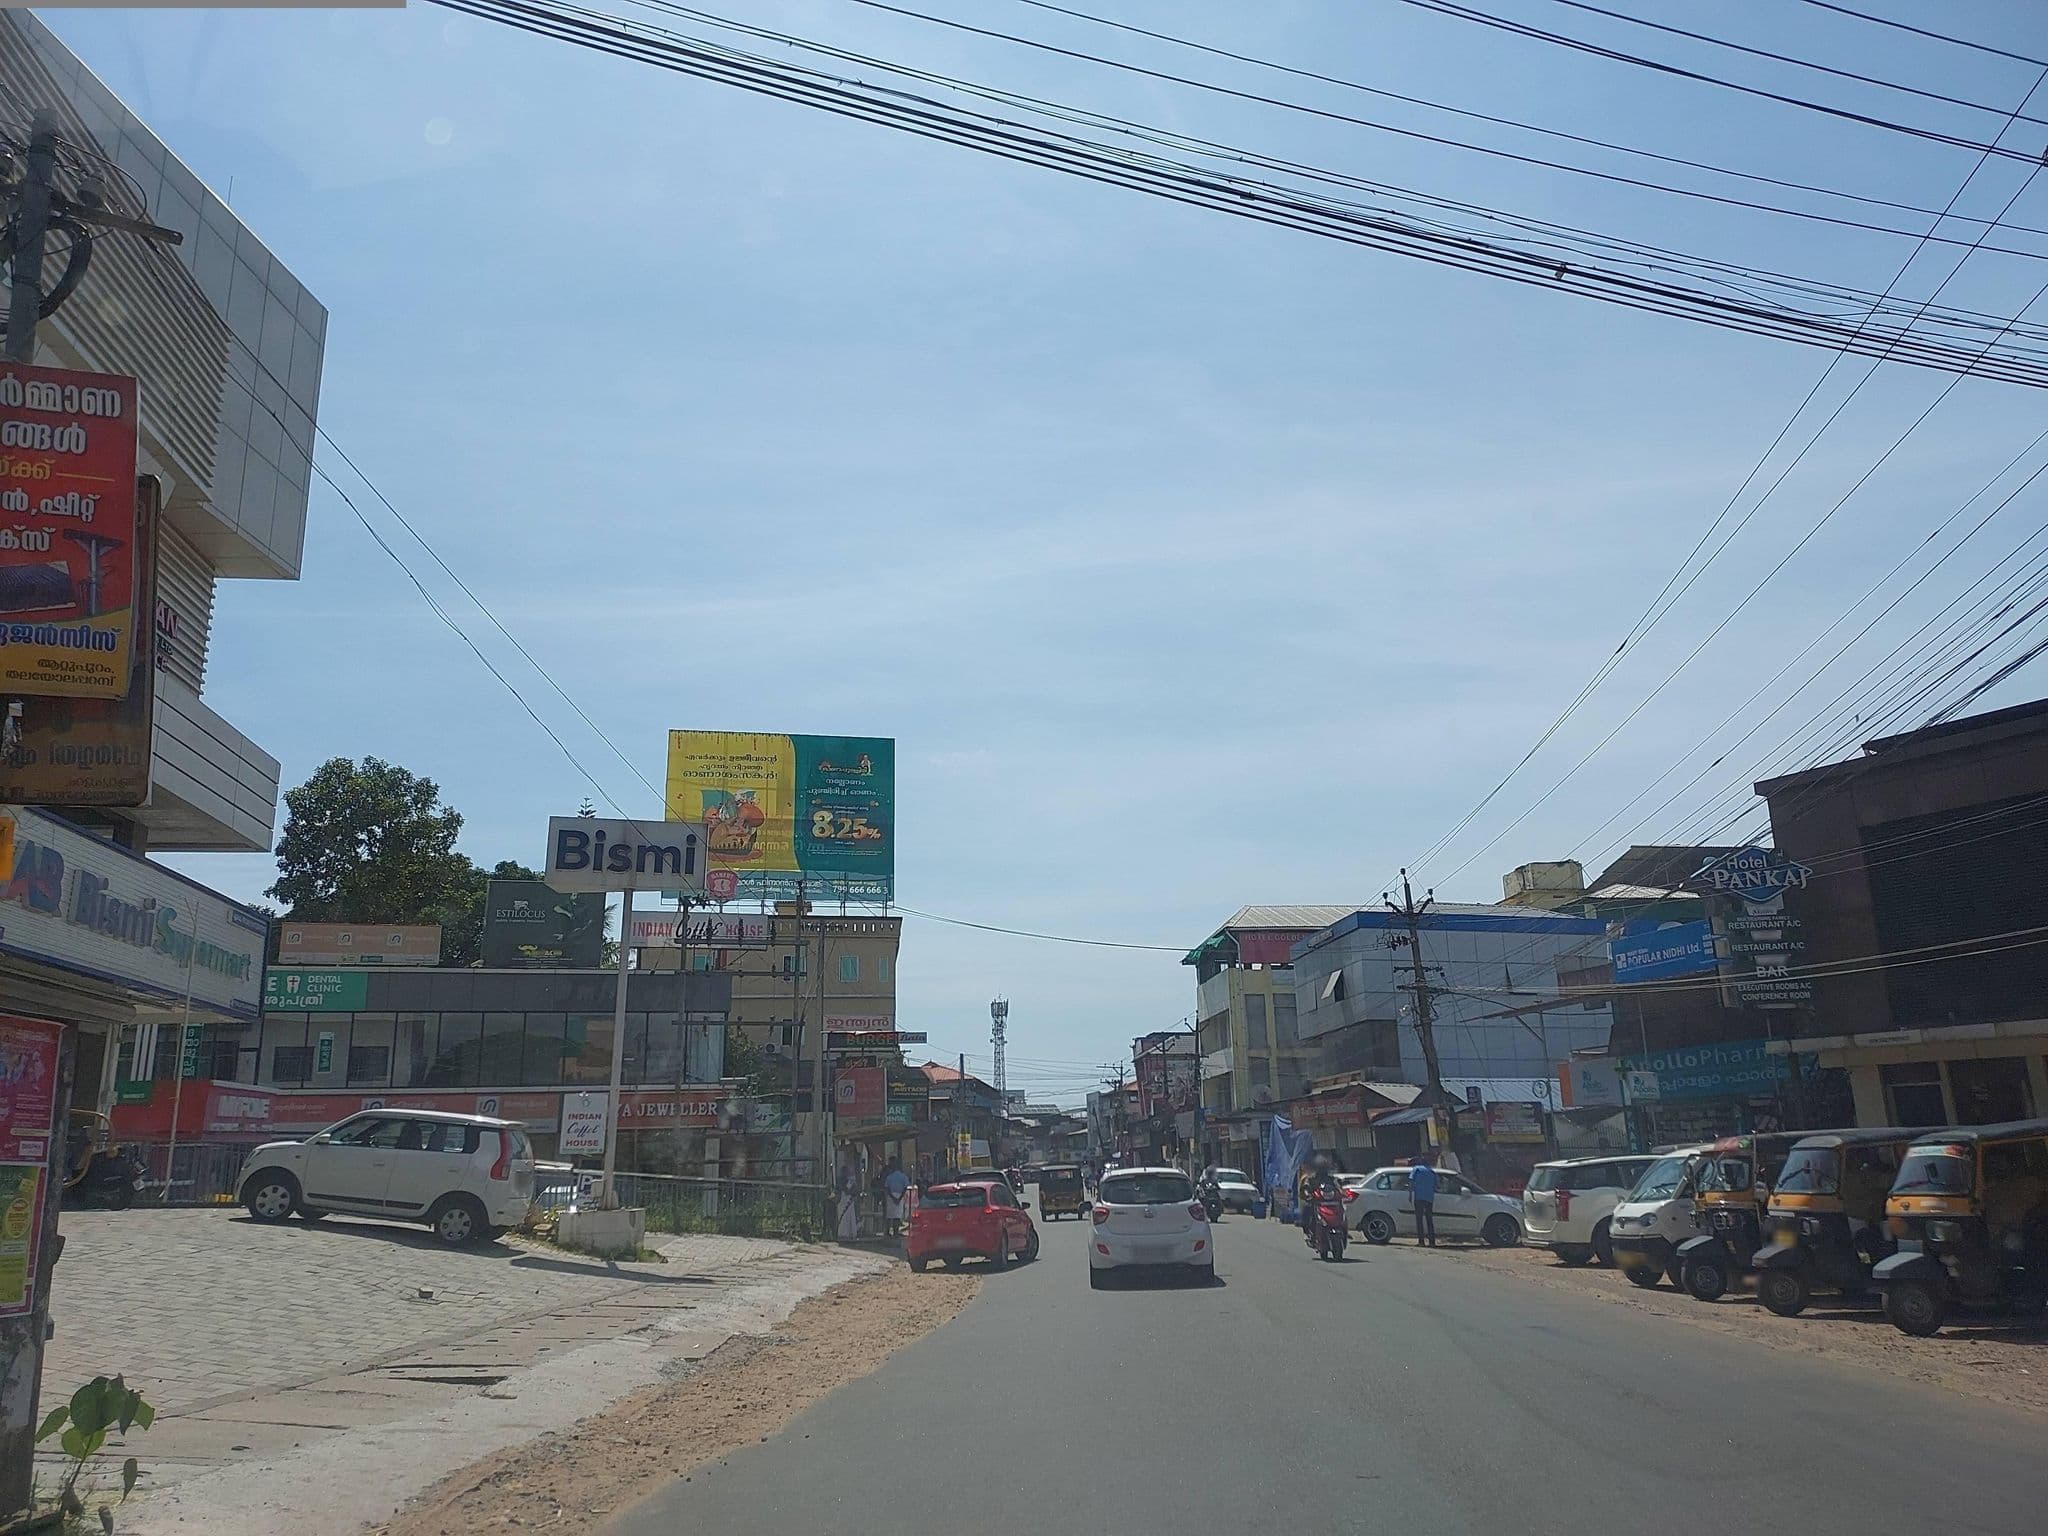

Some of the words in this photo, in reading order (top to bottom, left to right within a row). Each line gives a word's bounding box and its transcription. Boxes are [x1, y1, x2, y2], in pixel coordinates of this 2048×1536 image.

[811, 810, 882, 839] 8.25%
[554, 829, 697, 875] Bismi
[1726, 855, 1768, 870] Hotel
[1711, 868, 1808, 889] PANKAJ
[849, 886, 865, 894] 666
[866, 886, 882, 894] 666
[496, 909, 546, 918] ESTILOCUS
[632, 921, 673, 938] INDIAN
[1728, 920, 1784, 930] RESTAURANT
[1786, 919, 1801, 928] A/C
[1731, 942, 1788, 952] RESTAURANT
[1790, 941, 1805, 950] A/C
[1627, 951, 1661, 966] POPULAR
[1662, 945, 1686, 960] NIDHI
[1755, 965, 1789, 978] BAR
[266, 976, 278, 992] E
[307, 975, 343, 983] DENTAL
[306, 984, 343, 993] CLINIC
[1737, 983, 1774, 992] EXECUTIVE
[1741, 992, 1789, 1001] CONFERENCE
[1790, 991, 1812, 999] ROOM
[567, 1112, 602, 1121] INDIAN
[565, 1139, 599, 1147] HOUSE
